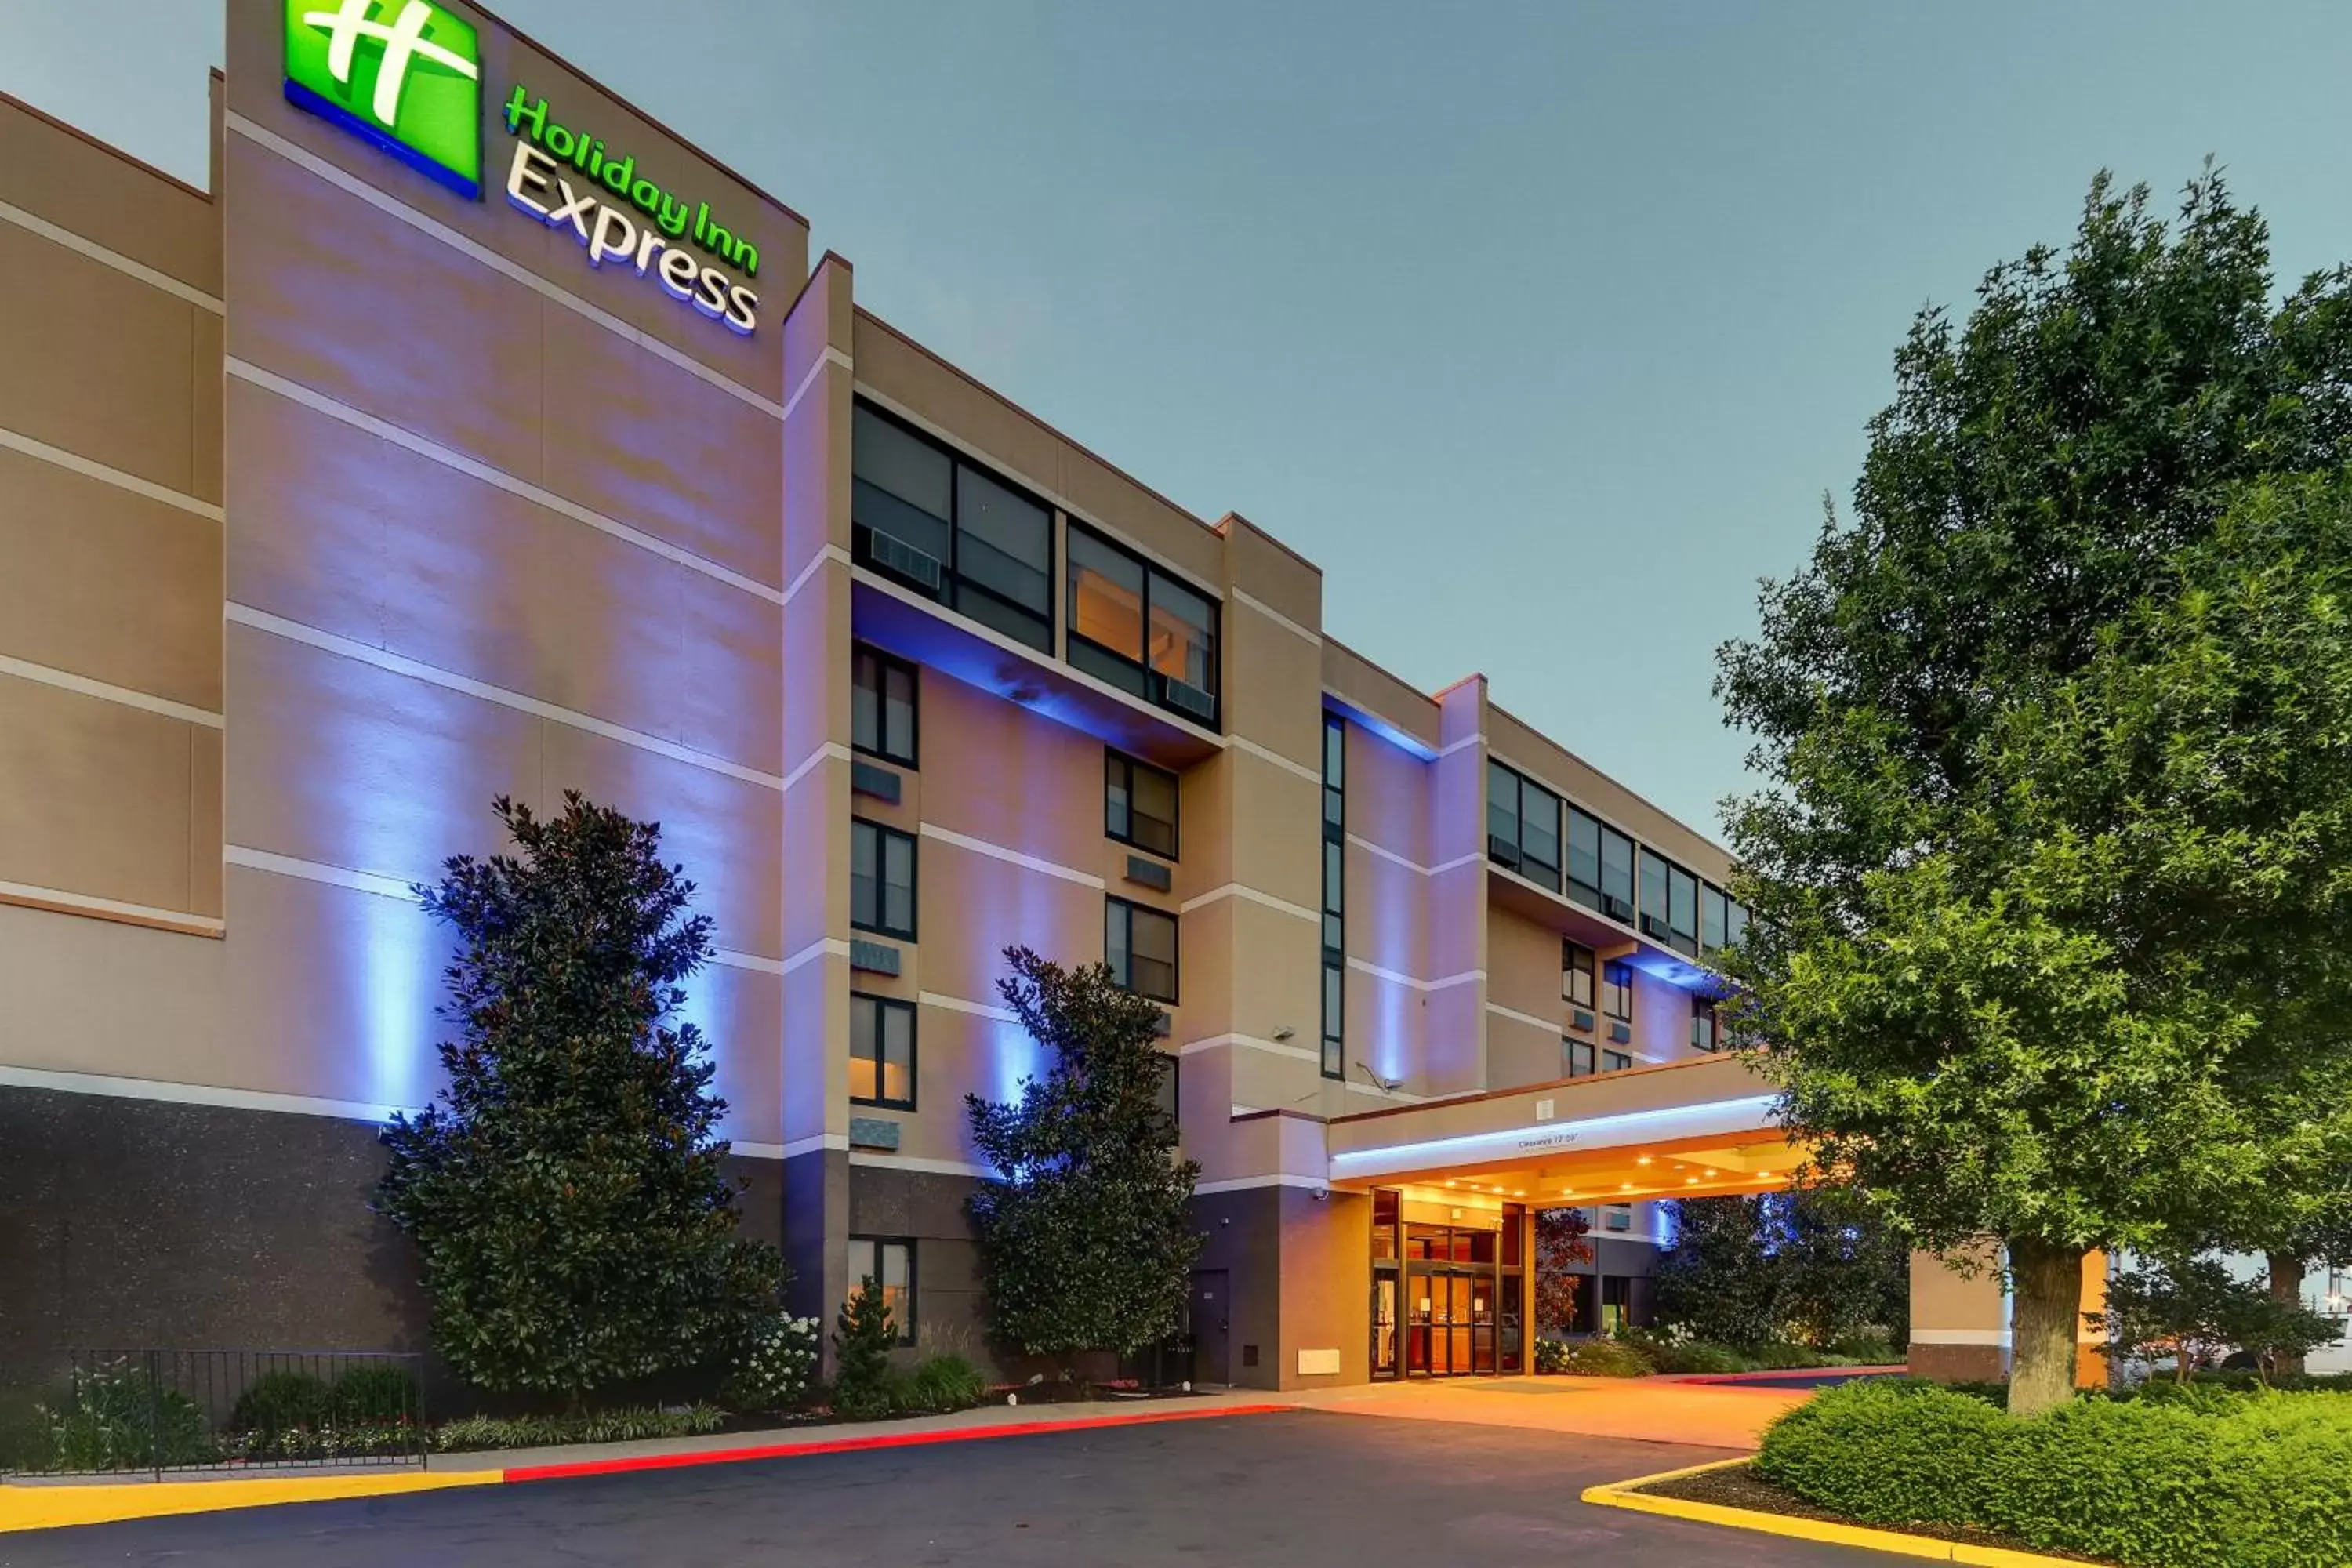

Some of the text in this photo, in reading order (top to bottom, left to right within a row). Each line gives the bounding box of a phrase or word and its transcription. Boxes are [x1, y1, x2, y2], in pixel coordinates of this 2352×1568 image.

[504, 84, 760, 276] Holiday Inn
[506, 139, 759, 332] Express
